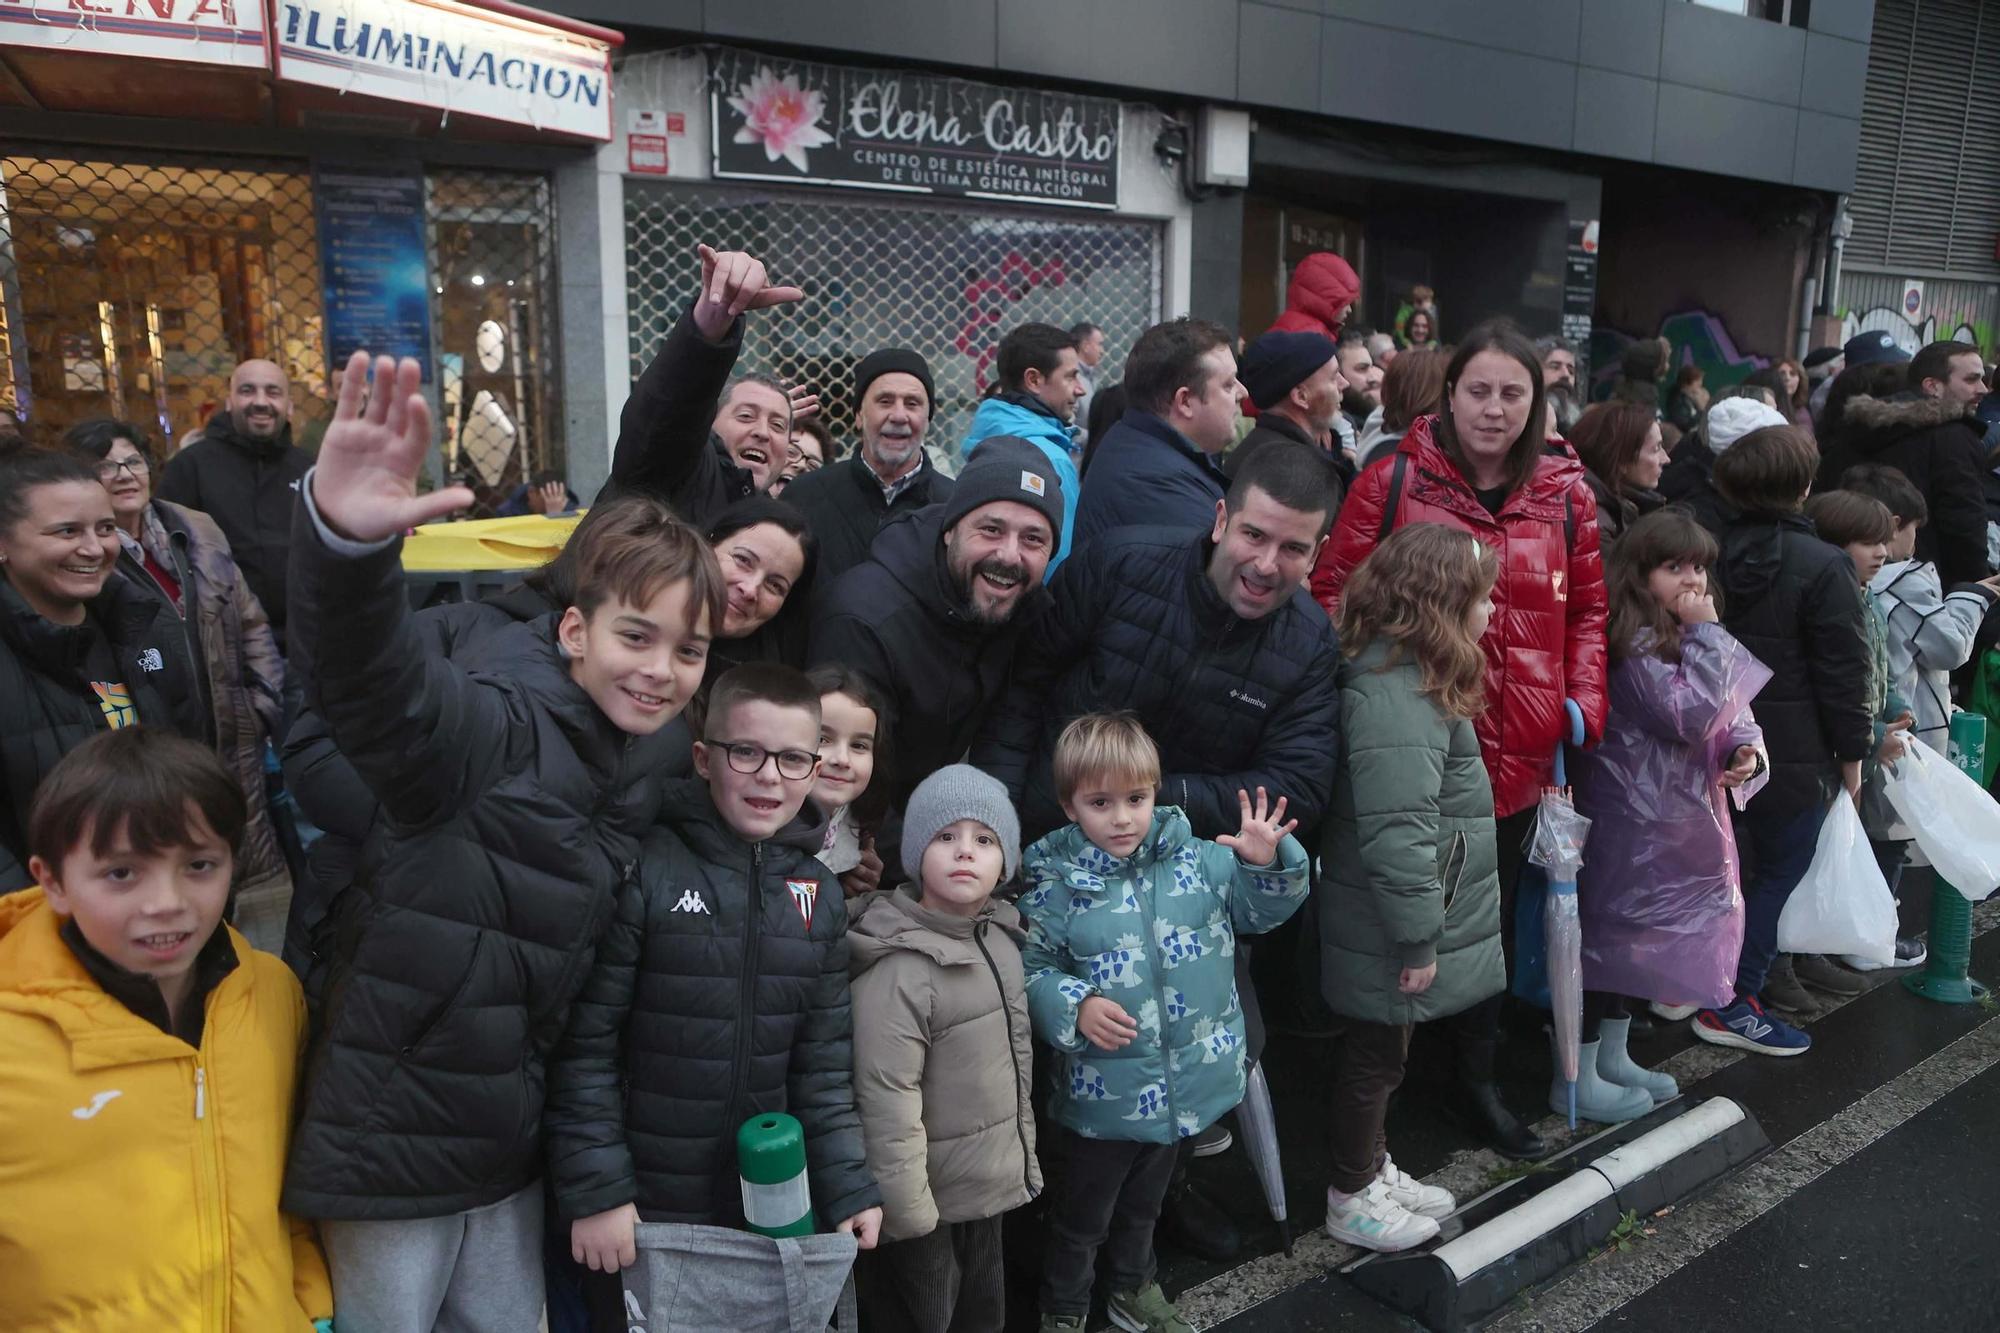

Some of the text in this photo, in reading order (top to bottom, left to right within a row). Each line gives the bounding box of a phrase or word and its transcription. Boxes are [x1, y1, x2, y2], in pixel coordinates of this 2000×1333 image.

[284, 4, 602, 107] ILUMINACION
[848, 81, 1111, 160] Elena Castro
[853, 149, 920, 169] CENTRO
[928, 156, 949, 170] DE
[1036, 168, 1108, 187] INTEGRAL
[882, 167, 902, 181] DE
